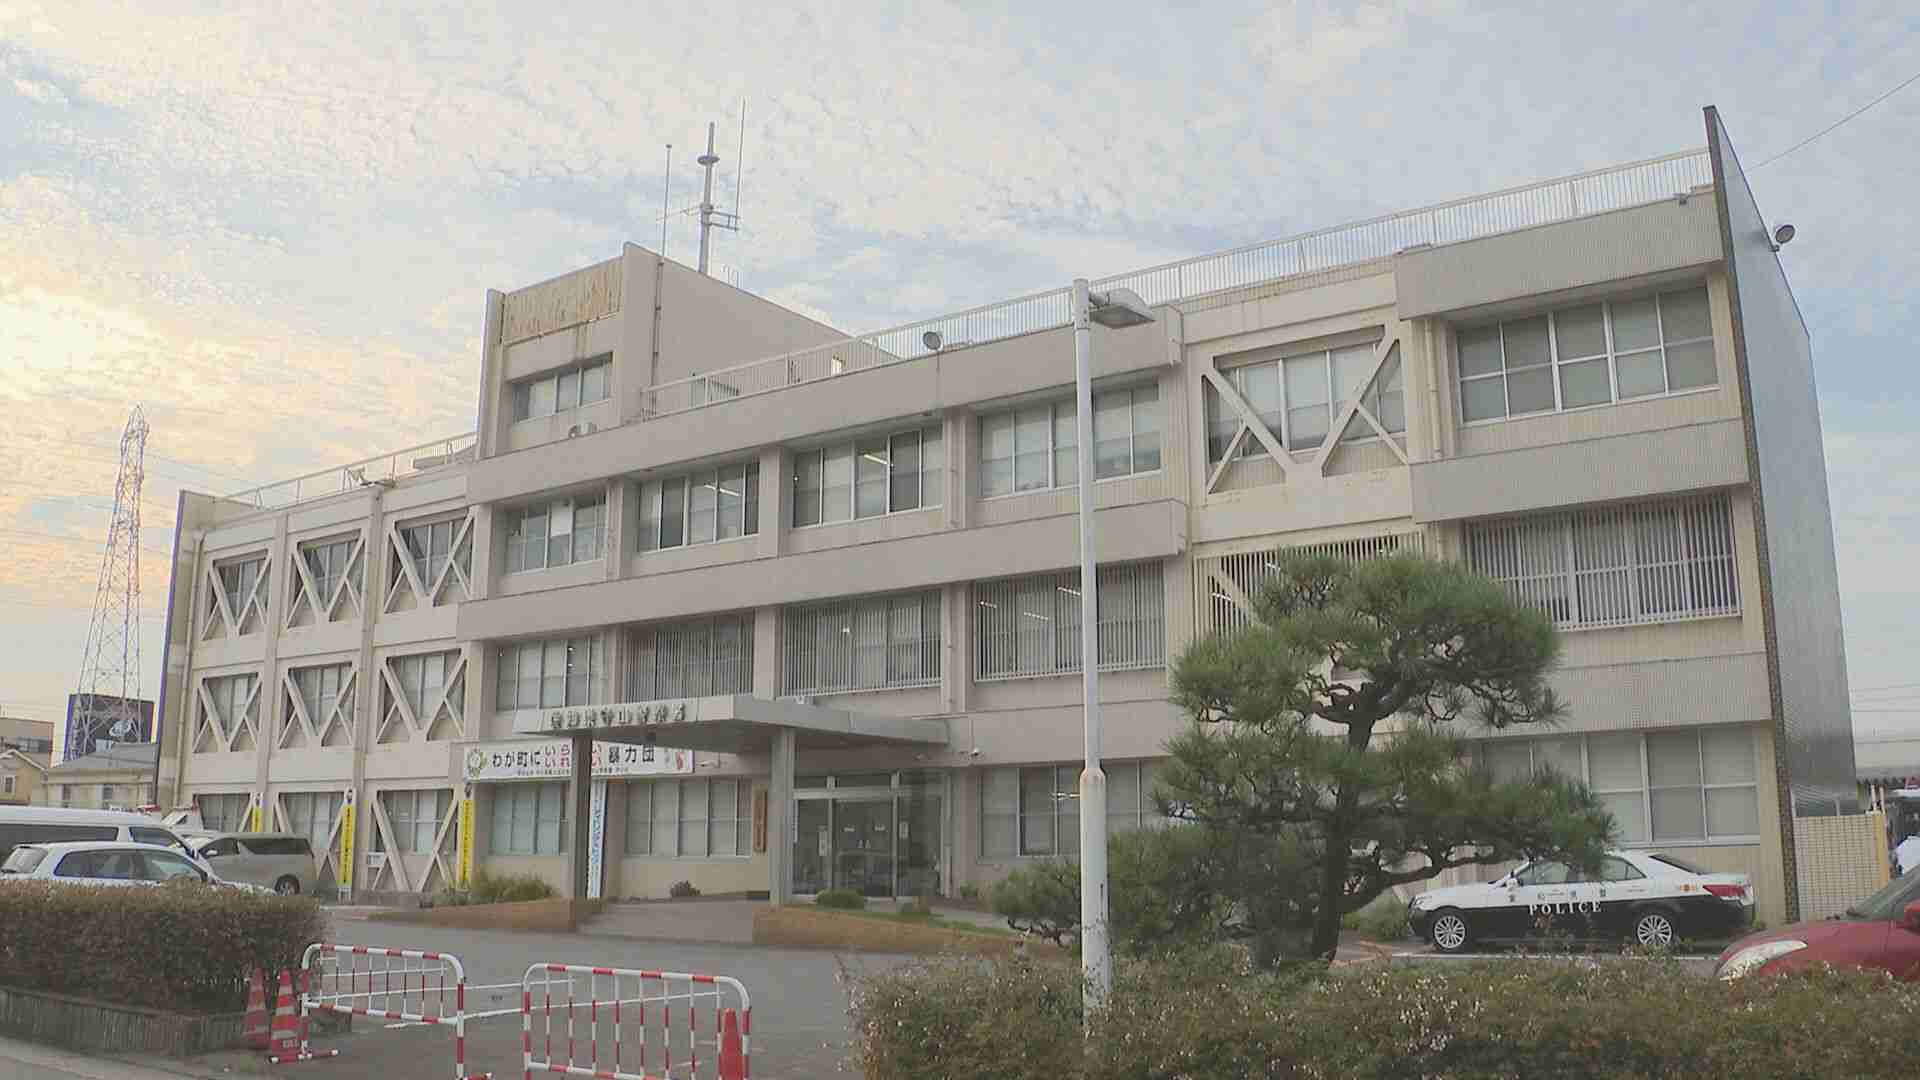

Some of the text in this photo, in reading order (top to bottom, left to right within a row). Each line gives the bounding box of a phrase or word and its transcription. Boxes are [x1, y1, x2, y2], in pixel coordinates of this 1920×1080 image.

[493, 751, 541, 768] わが町に
[609, 744, 654, 763] 暴力団
[1528, 899, 1602, 915] POLICE
